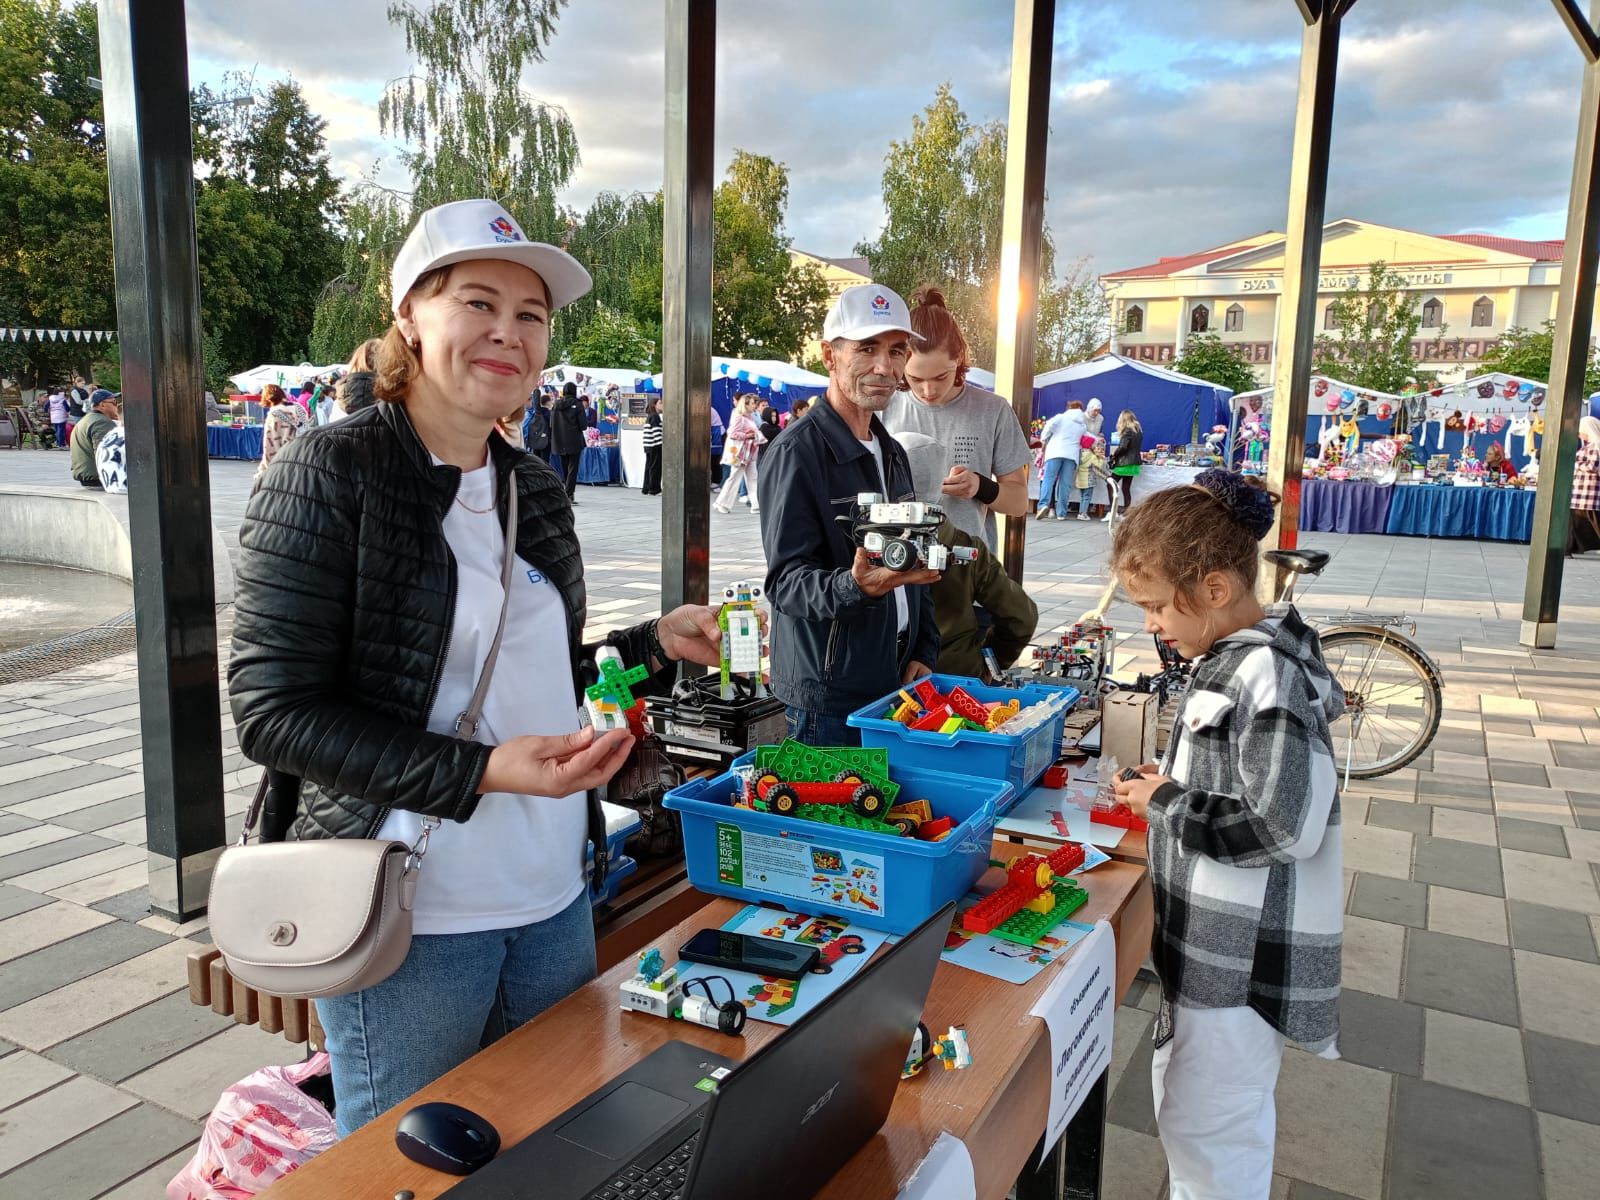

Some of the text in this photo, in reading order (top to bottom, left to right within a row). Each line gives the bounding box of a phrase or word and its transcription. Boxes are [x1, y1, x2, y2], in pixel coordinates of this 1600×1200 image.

[1241, 279, 1274, 290] БУА
[719, 849, 733, 858] 102
[800, 1080, 840, 1125] acer
